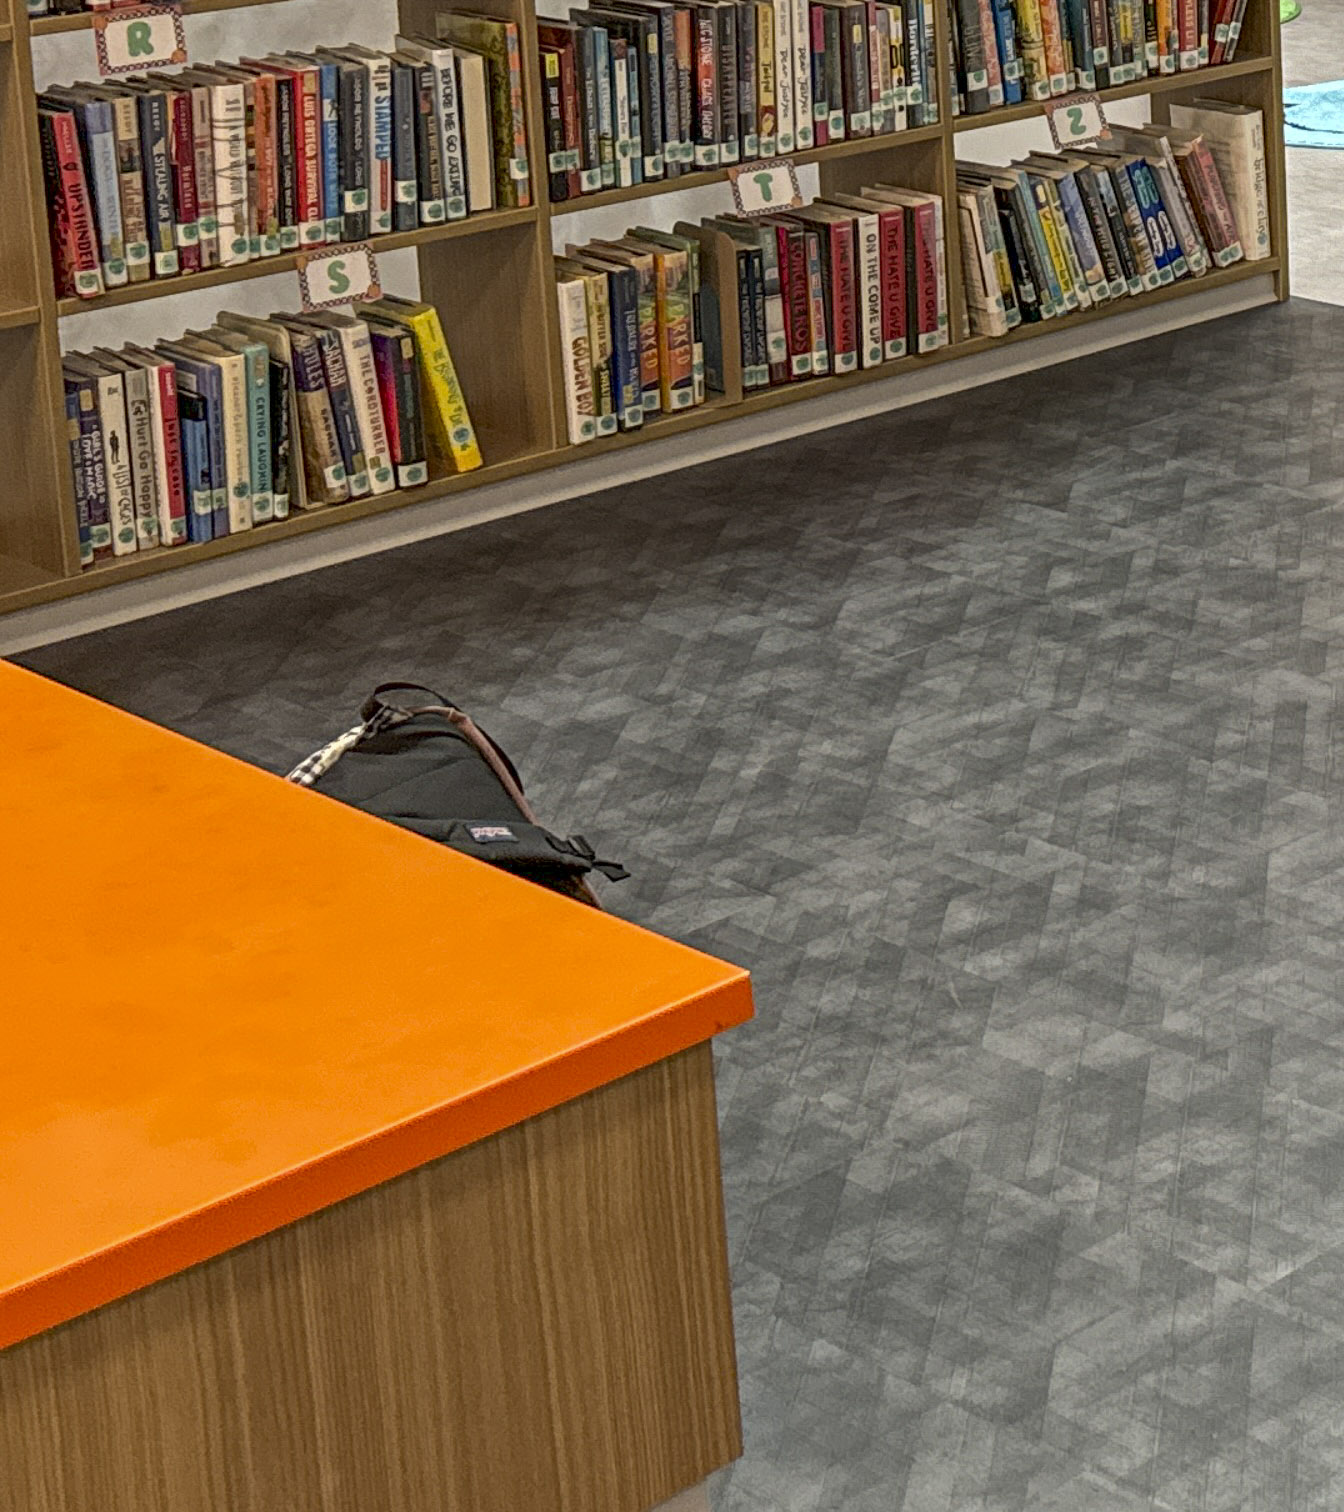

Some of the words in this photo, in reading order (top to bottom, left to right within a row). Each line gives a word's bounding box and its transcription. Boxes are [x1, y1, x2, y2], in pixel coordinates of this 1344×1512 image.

[126, 21, 154, 58] R
[439, 67, 456, 110] BEFORE
[303, 95, 316, 118] LUIS
[444, 112, 459, 132] WE
[1066, 107, 1087, 136] Z
[304, 119, 317, 157] ORTEGA
[374, 95, 392, 161] STAMPED
[446, 134, 459, 153] GO
[153, 155, 168, 202] STEALING
[305, 159, 319, 204] SURVIVAL
[753, 172, 775, 202] T
[1254, 158, 1267, 197] bridge
[68, 184, 96, 270] UPSTANDER
[157, 203, 171, 221] AIR
[1255, 210, 1268, 236] clay
[865, 233, 878, 253] ON
[886, 226, 899, 251] THE
[326, 259, 350, 295] S
[866, 257, 879, 281] THE
[887, 253, 900, 288] HATE
[923, 249, 935, 286] HATE
[840, 267, 852, 303] HATE
[888, 292, 900, 303] U
[868, 284, 881, 323] COME
[924, 299, 936, 333] GIVE
[640, 307, 660, 368] PARKED
[674, 303, 692, 365] PARKED
[841, 319, 853, 352] GIVE
[869, 327, 882, 345] UP
[888, 307, 901, 339] GIVE
[302, 347, 326, 389] HOLES
[324, 346, 348, 388] SACHAR
[359, 354, 372, 378] THE
[571, 336, 591, 391] GOLDEN
[256, 396, 267, 438] CRYING
[576, 391, 596, 418] BOY
[138, 417, 151, 447] Hurt
[139, 449, 151, 469] Go
[257, 441, 269, 492] LAUGHIN
[112, 468, 132, 489] LIST
[117, 497, 132, 526] CAGES
[136, 474, 153, 518] Happy
